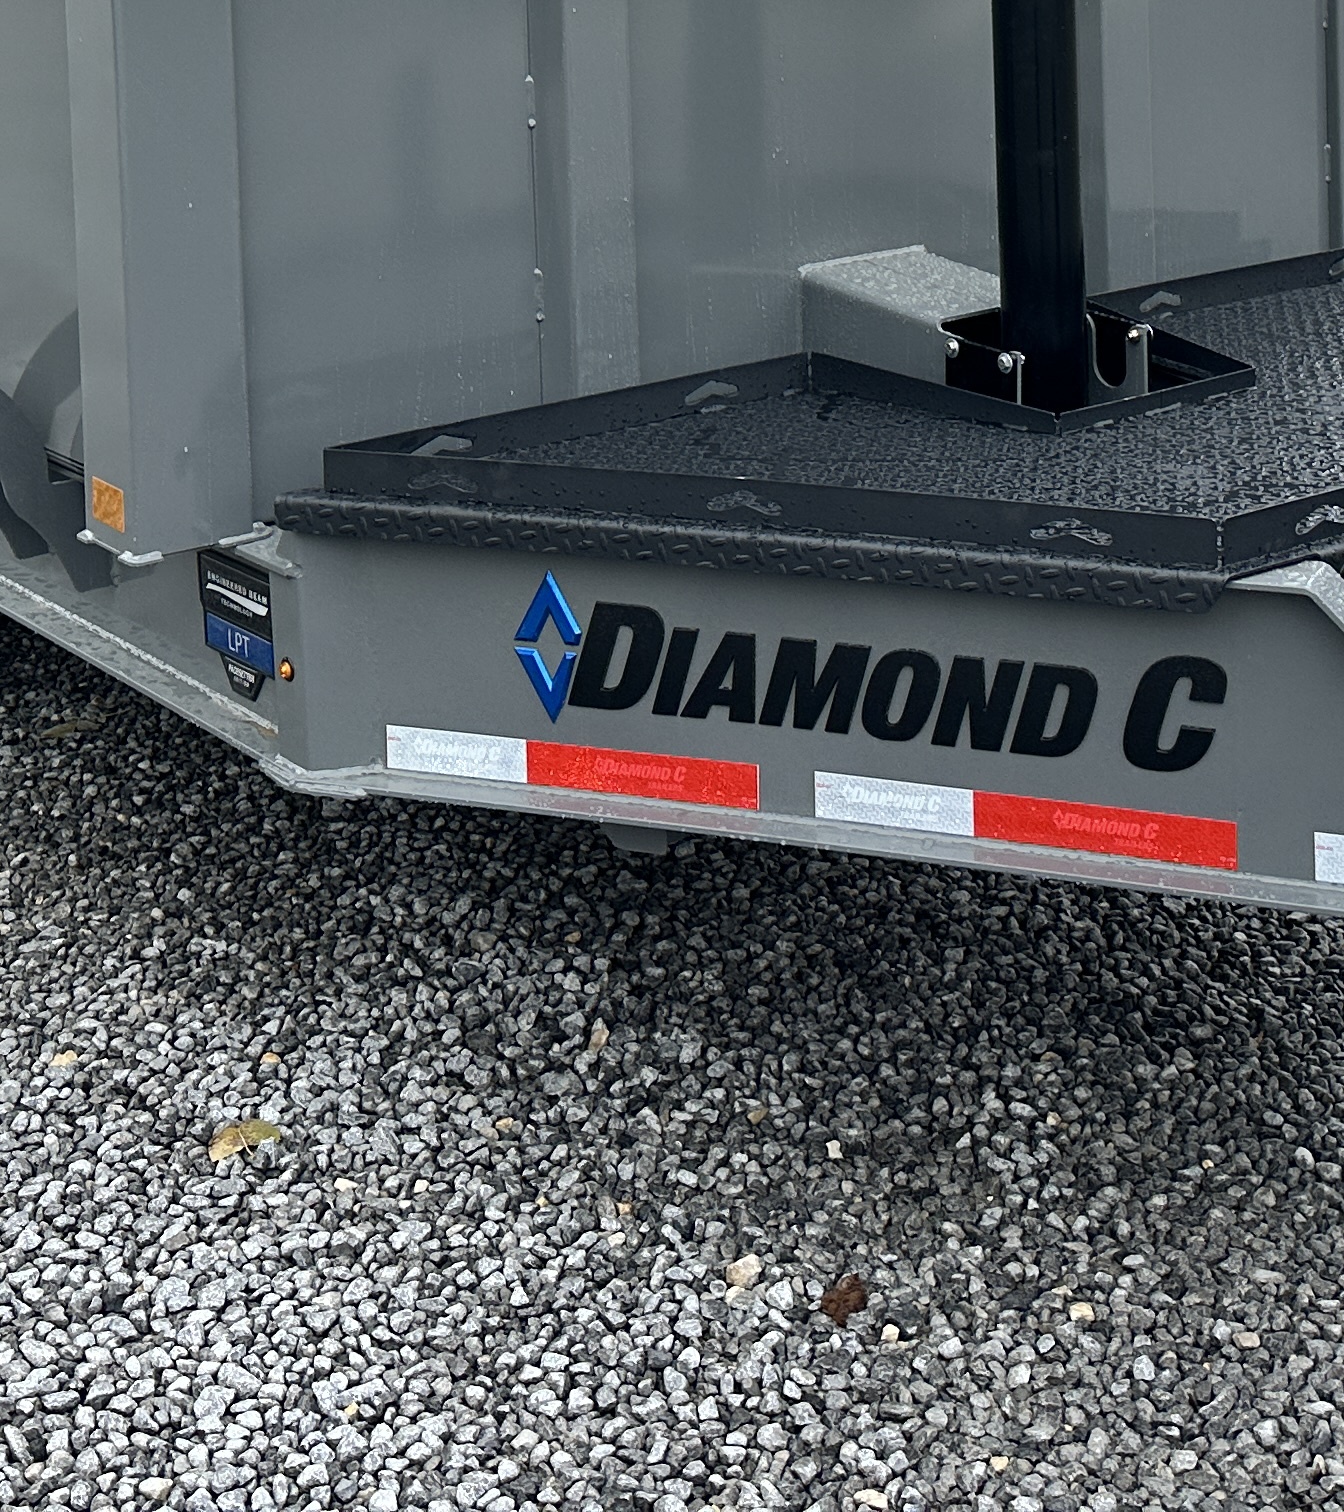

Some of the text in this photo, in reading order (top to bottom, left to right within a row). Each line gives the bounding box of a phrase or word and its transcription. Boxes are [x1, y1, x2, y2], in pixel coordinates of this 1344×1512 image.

[227, 628, 250, 658] LPT
[567, 600, 1227, 773] DIAMOND C
[673, 765, 687, 783] C
[927, 794, 941, 813] C
[1144, 822, 1160, 840] C
